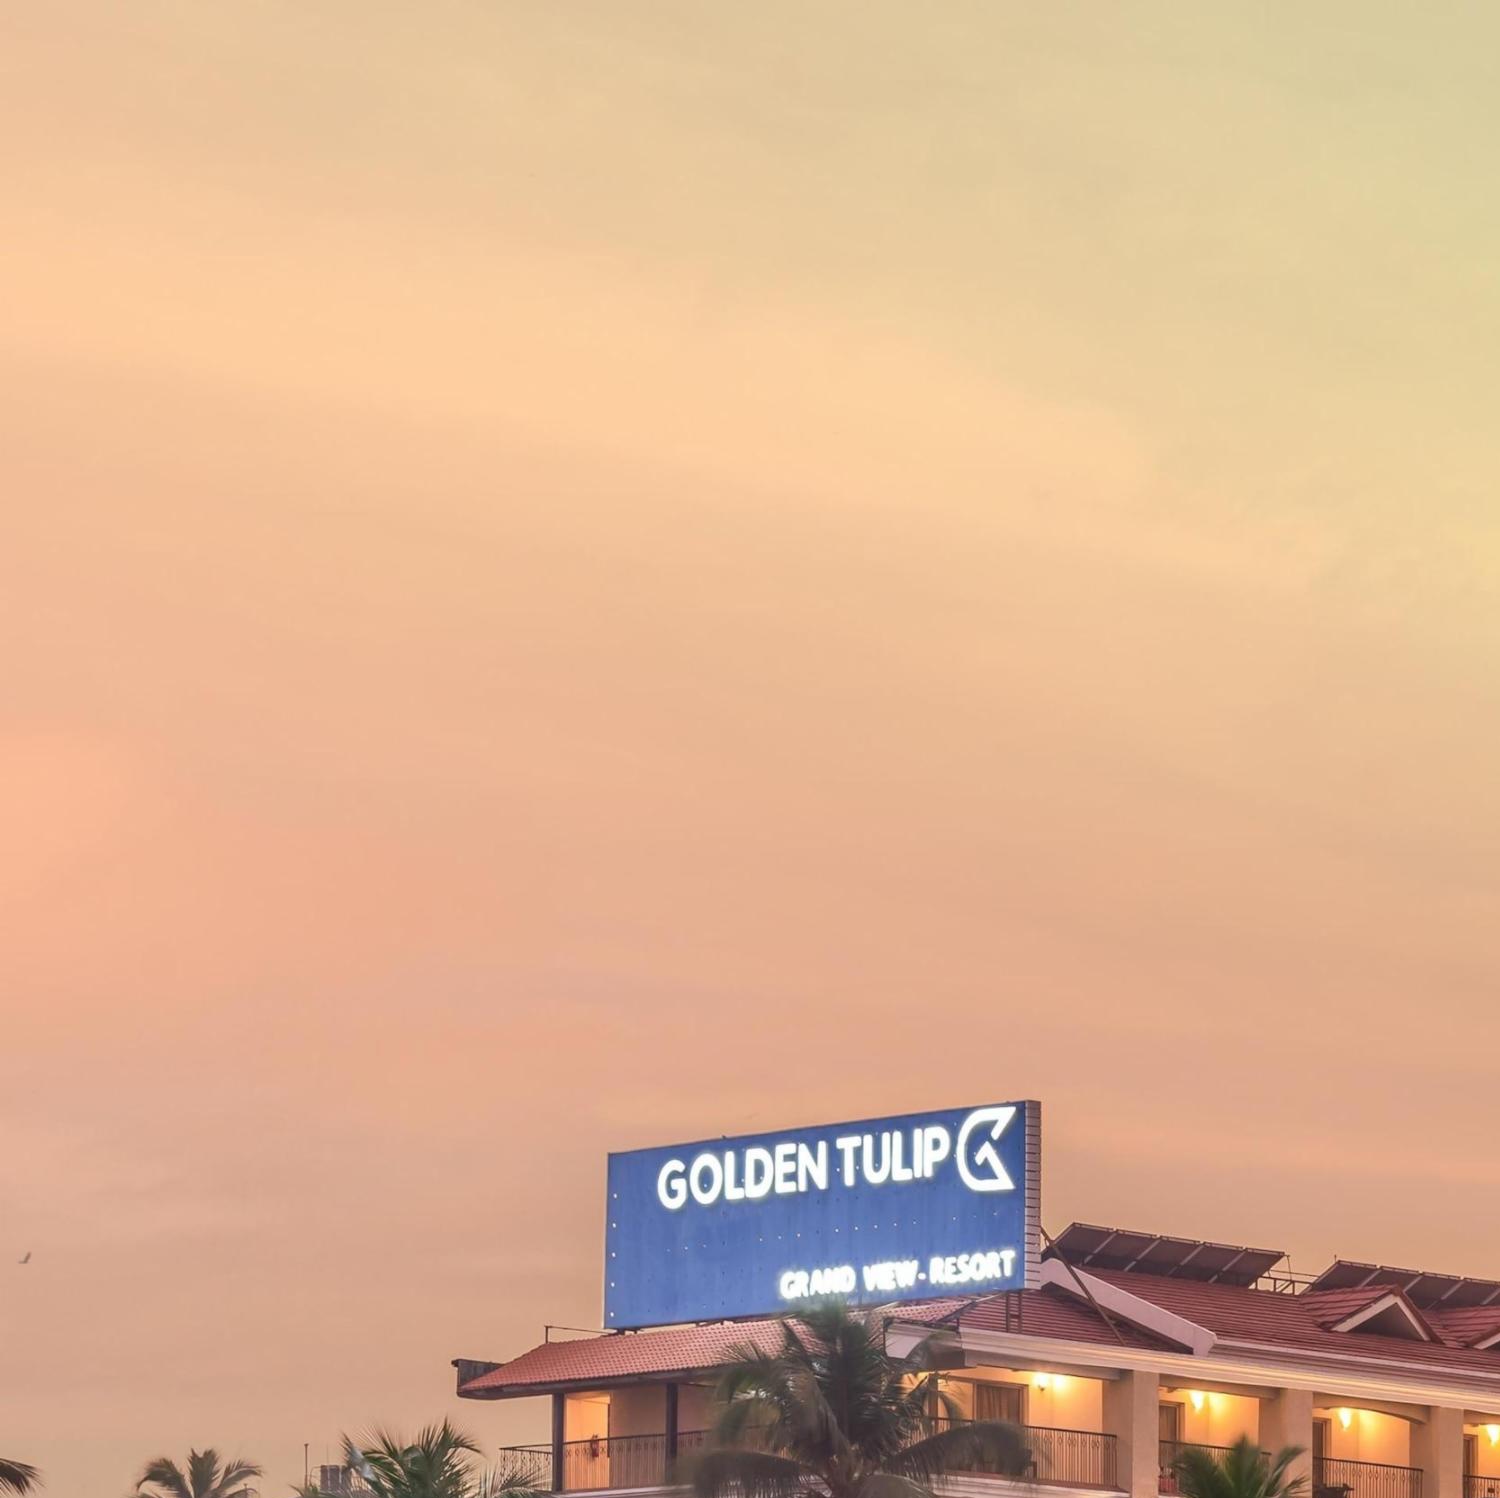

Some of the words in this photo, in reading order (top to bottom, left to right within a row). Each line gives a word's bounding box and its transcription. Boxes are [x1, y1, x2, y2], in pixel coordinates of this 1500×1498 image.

[657, 1141, 827, 1210] GOLDEN
[836, 1126, 950, 1186] TULIP
[779, 1265, 856, 1300] GRAND
[929, 1249, 1016, 1284] RESORT
